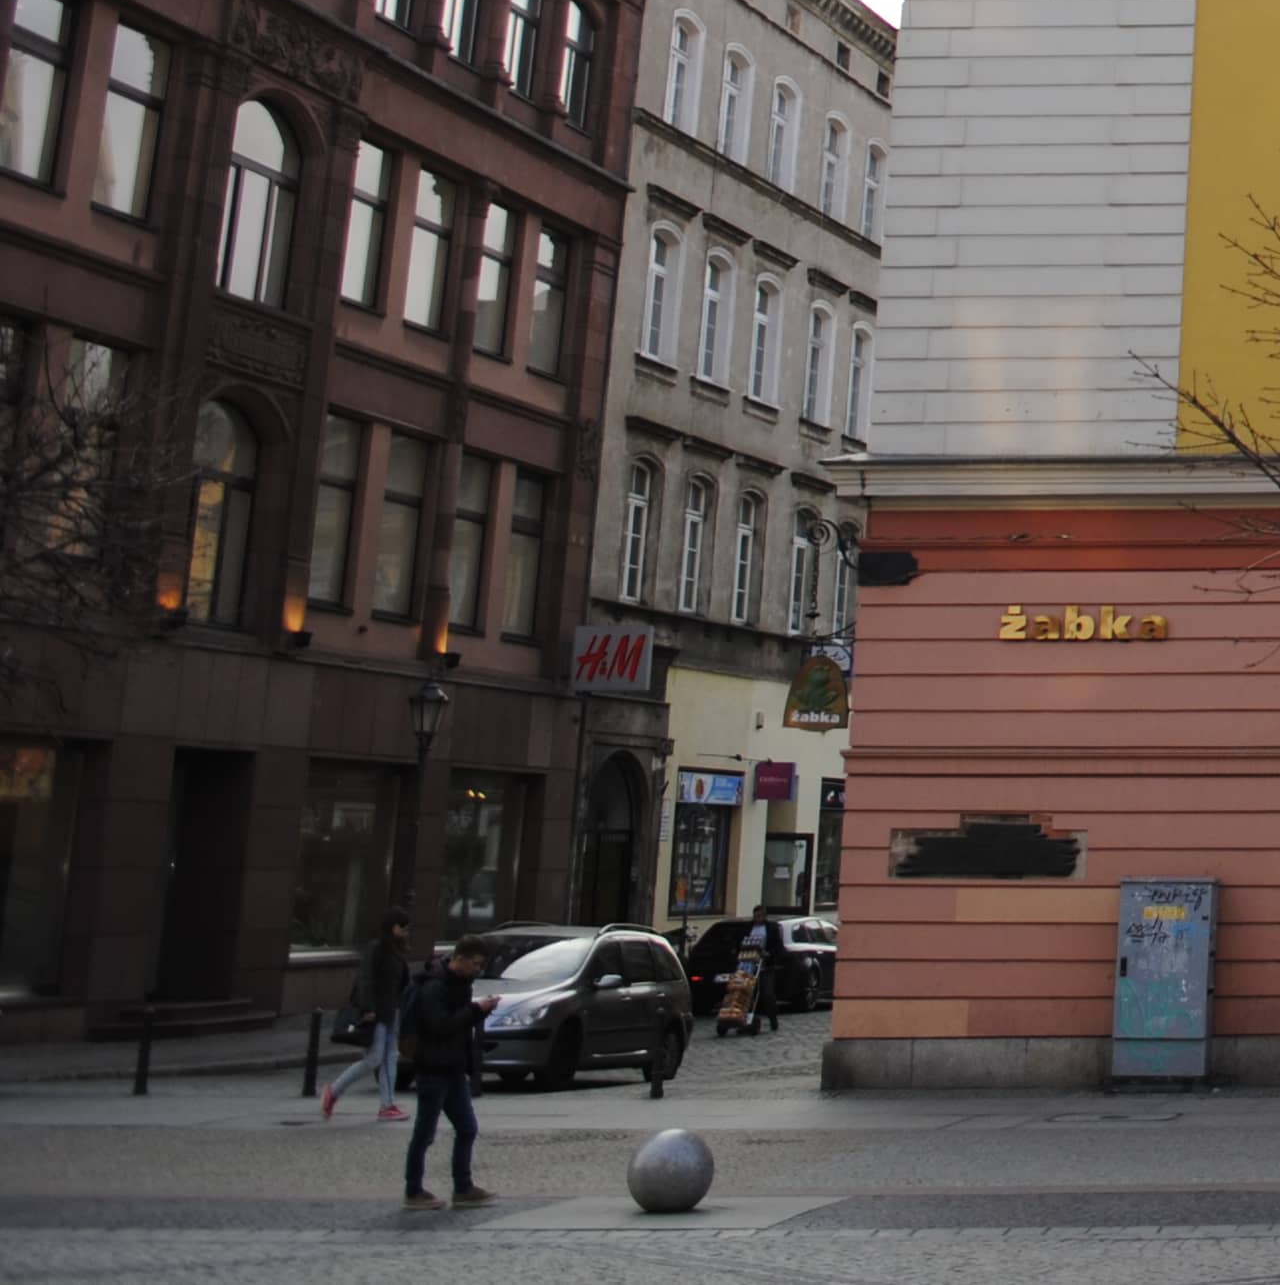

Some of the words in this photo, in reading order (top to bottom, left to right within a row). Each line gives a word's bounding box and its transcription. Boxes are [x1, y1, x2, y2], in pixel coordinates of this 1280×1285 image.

[999, 605, 1168, 640] żabka
[576, 633, 646, 683] H&M
[791, 709, 841, 723] żabka
